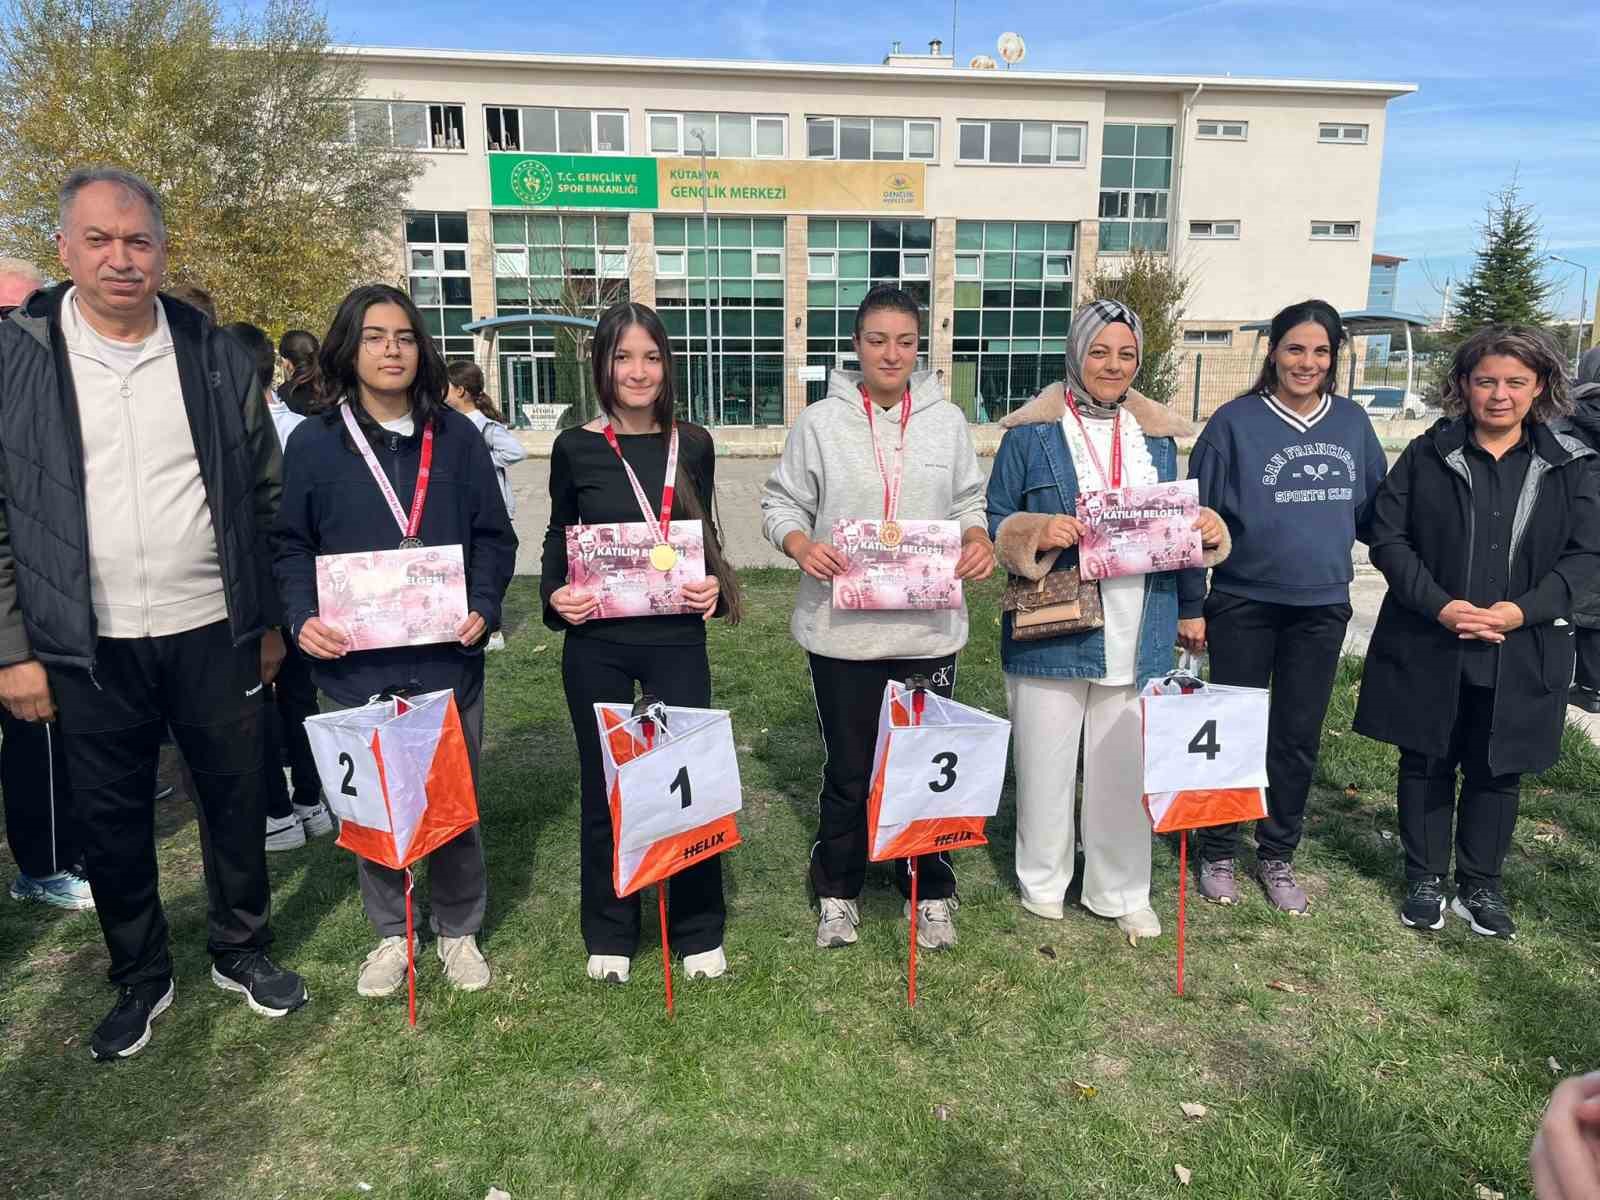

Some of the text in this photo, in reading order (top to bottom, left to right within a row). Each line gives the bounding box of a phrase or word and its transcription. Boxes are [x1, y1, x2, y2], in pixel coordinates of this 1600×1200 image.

[556, 172, 638, 184] T.C. GENÇLİK VE
[557, 184, 638, 195] SPOR BAKANLIĞI
[730, 185, 787, 199] MERKEZİ
[1262, 453, 1288, 485] SAN
[1274, 488, 1326, 503] SPORTS
[1103, 507, 1182, 520] KATILIM BELGESİ
[597, 546, 640, 558] KATILIM
[932, 667, 951, 687] CK
[1187, 719, 1221, 761] 4
[338, 751, 358, 797] 2
[928, 751, 959, 793] 3
[669, 765, 692, 809] 1
[683, 831, 725, 860] HELIX
[934, 831, 974, 846] HELIX
